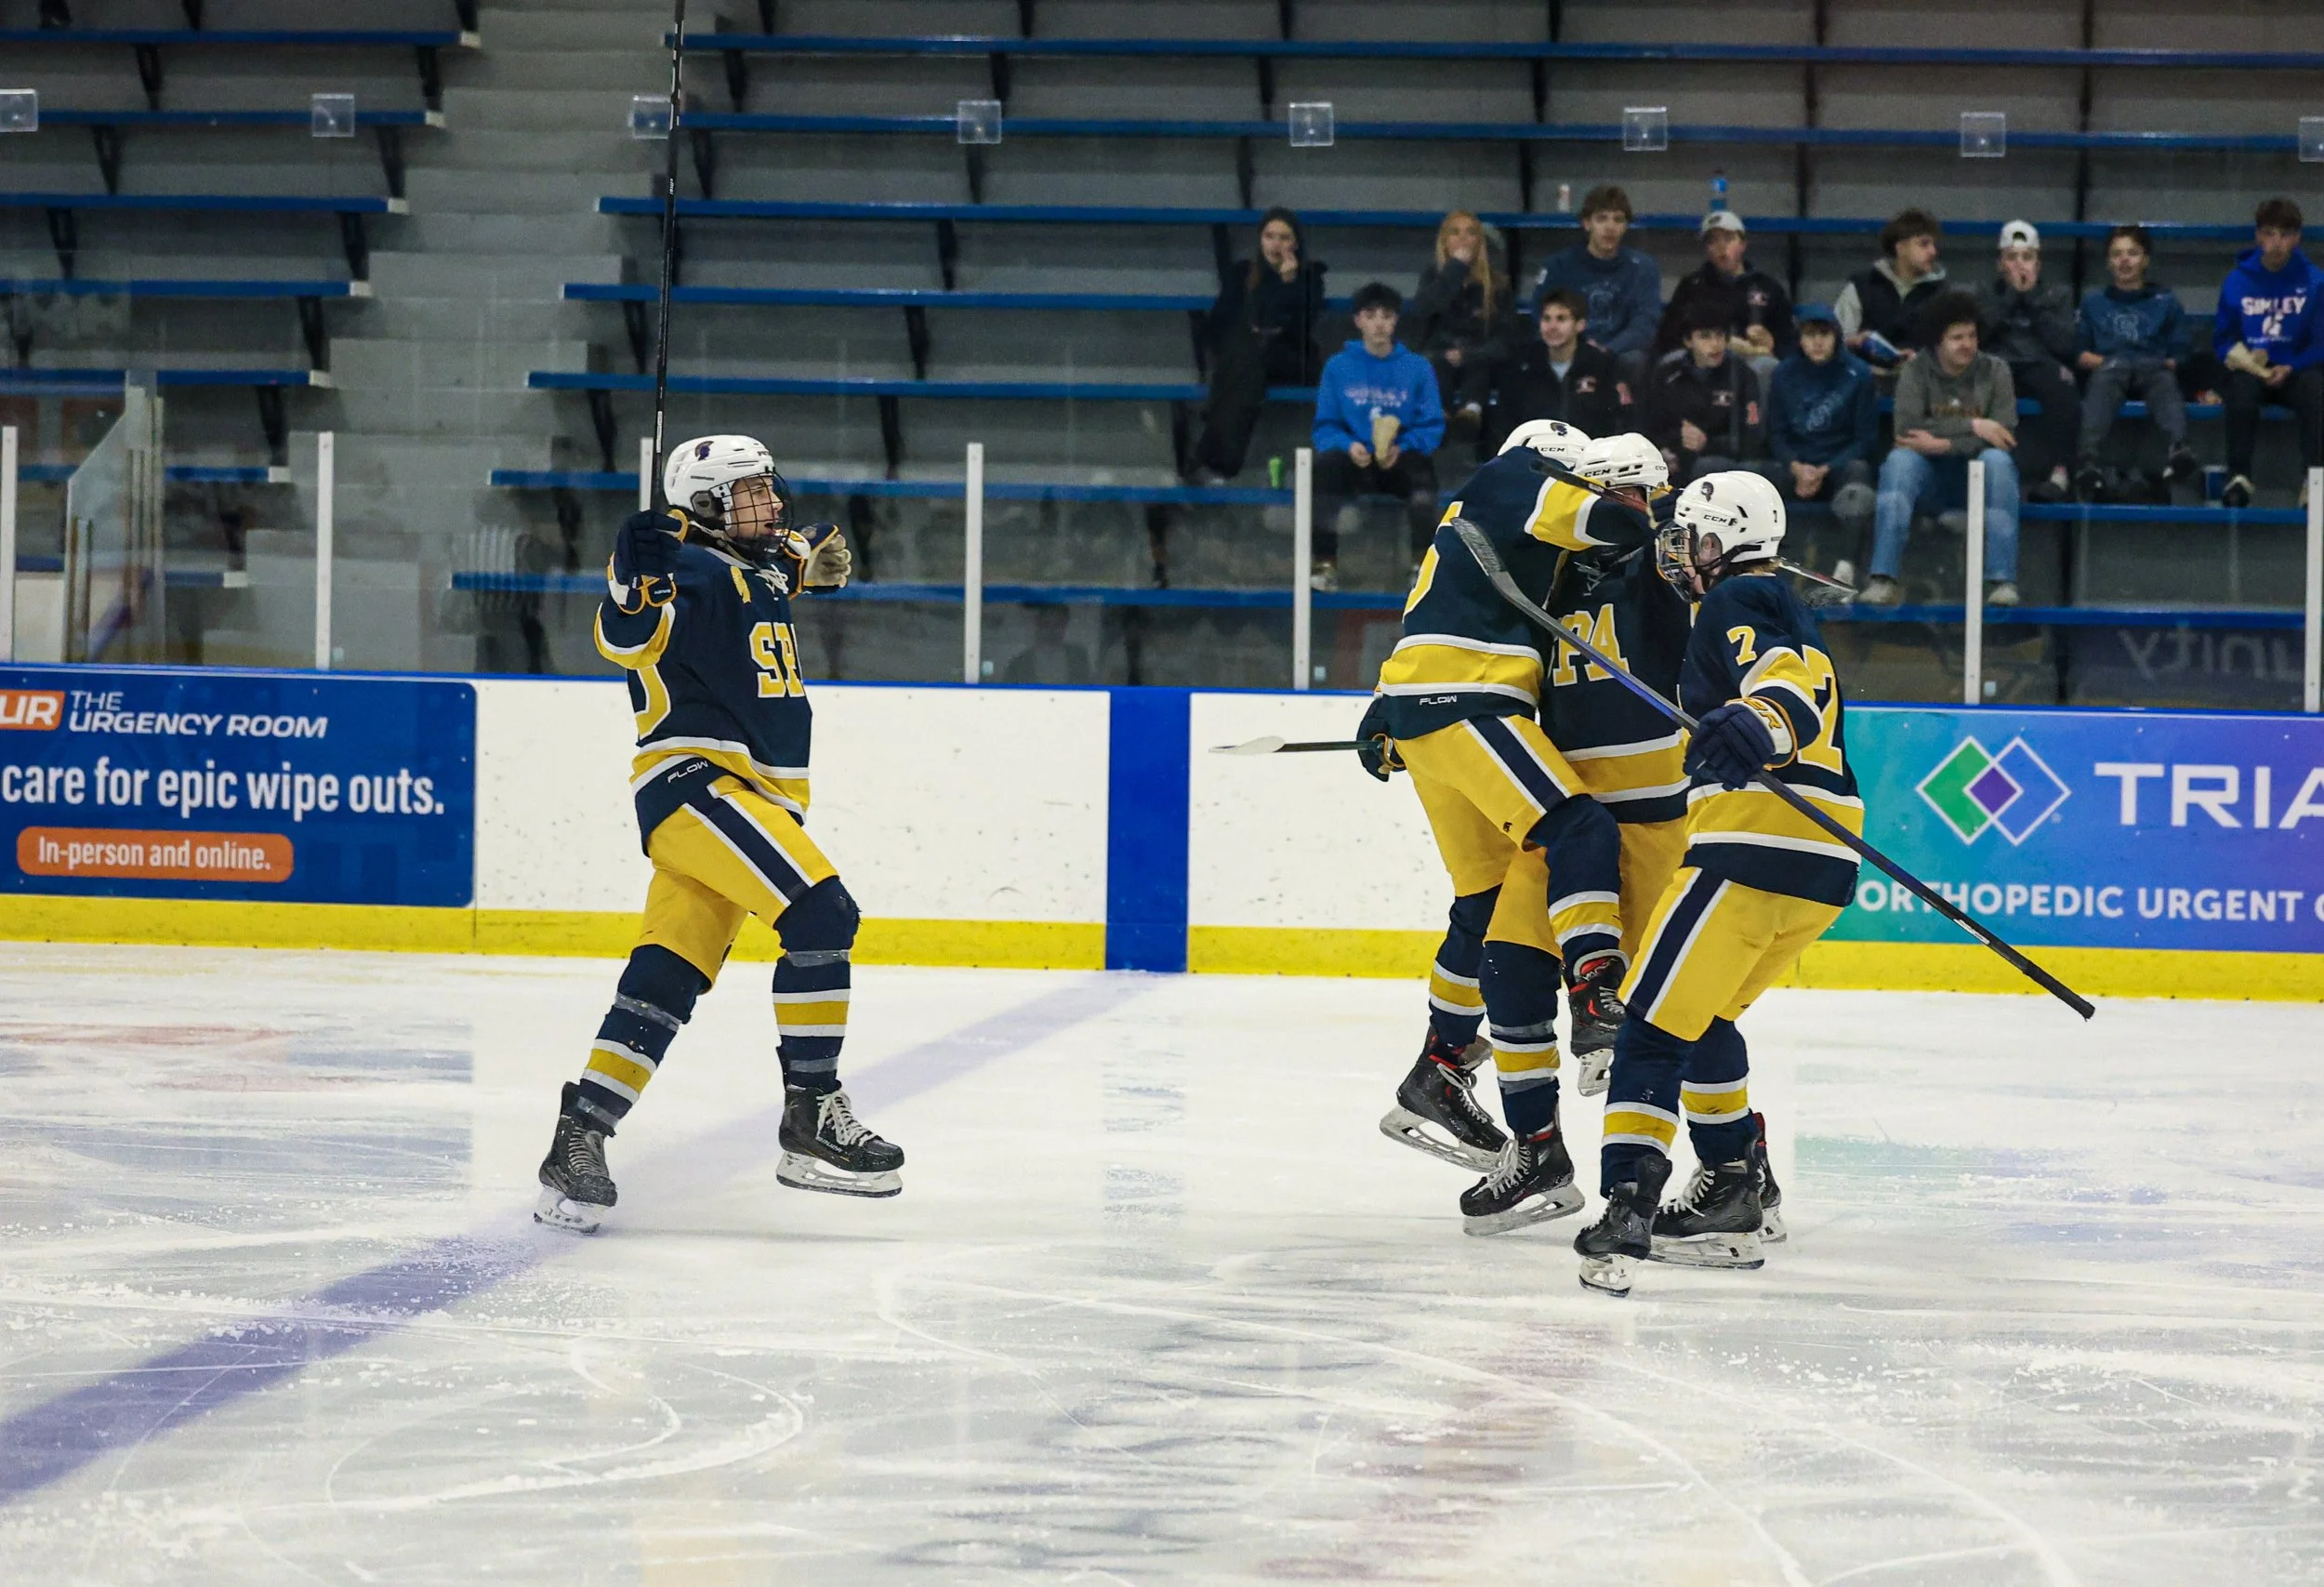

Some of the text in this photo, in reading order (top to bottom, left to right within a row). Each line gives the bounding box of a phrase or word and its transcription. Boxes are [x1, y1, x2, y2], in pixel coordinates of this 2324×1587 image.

[1583, 468, 1612, 478] CCM
[1703, 513, 1728, 524] CCM
[748, 621, 806, 698] SP
[1726, 625, 1758, 667] 7
[0, 694, 59, 726] UR
[70, 689, 125, 712] THE
[1419, 694, 1458, 706] FLOW
[68, 710, 328, 739] URGENCY ROOM
[667, 760, 709, 784] FLOW
[1, 755, 445, 823] care for epic wipe outs.
[2093, 761, 2324, 829] TRIA
[38, 835, 271, 871] In-person and online.
[2137, 886, 2304, 922] URGENT
